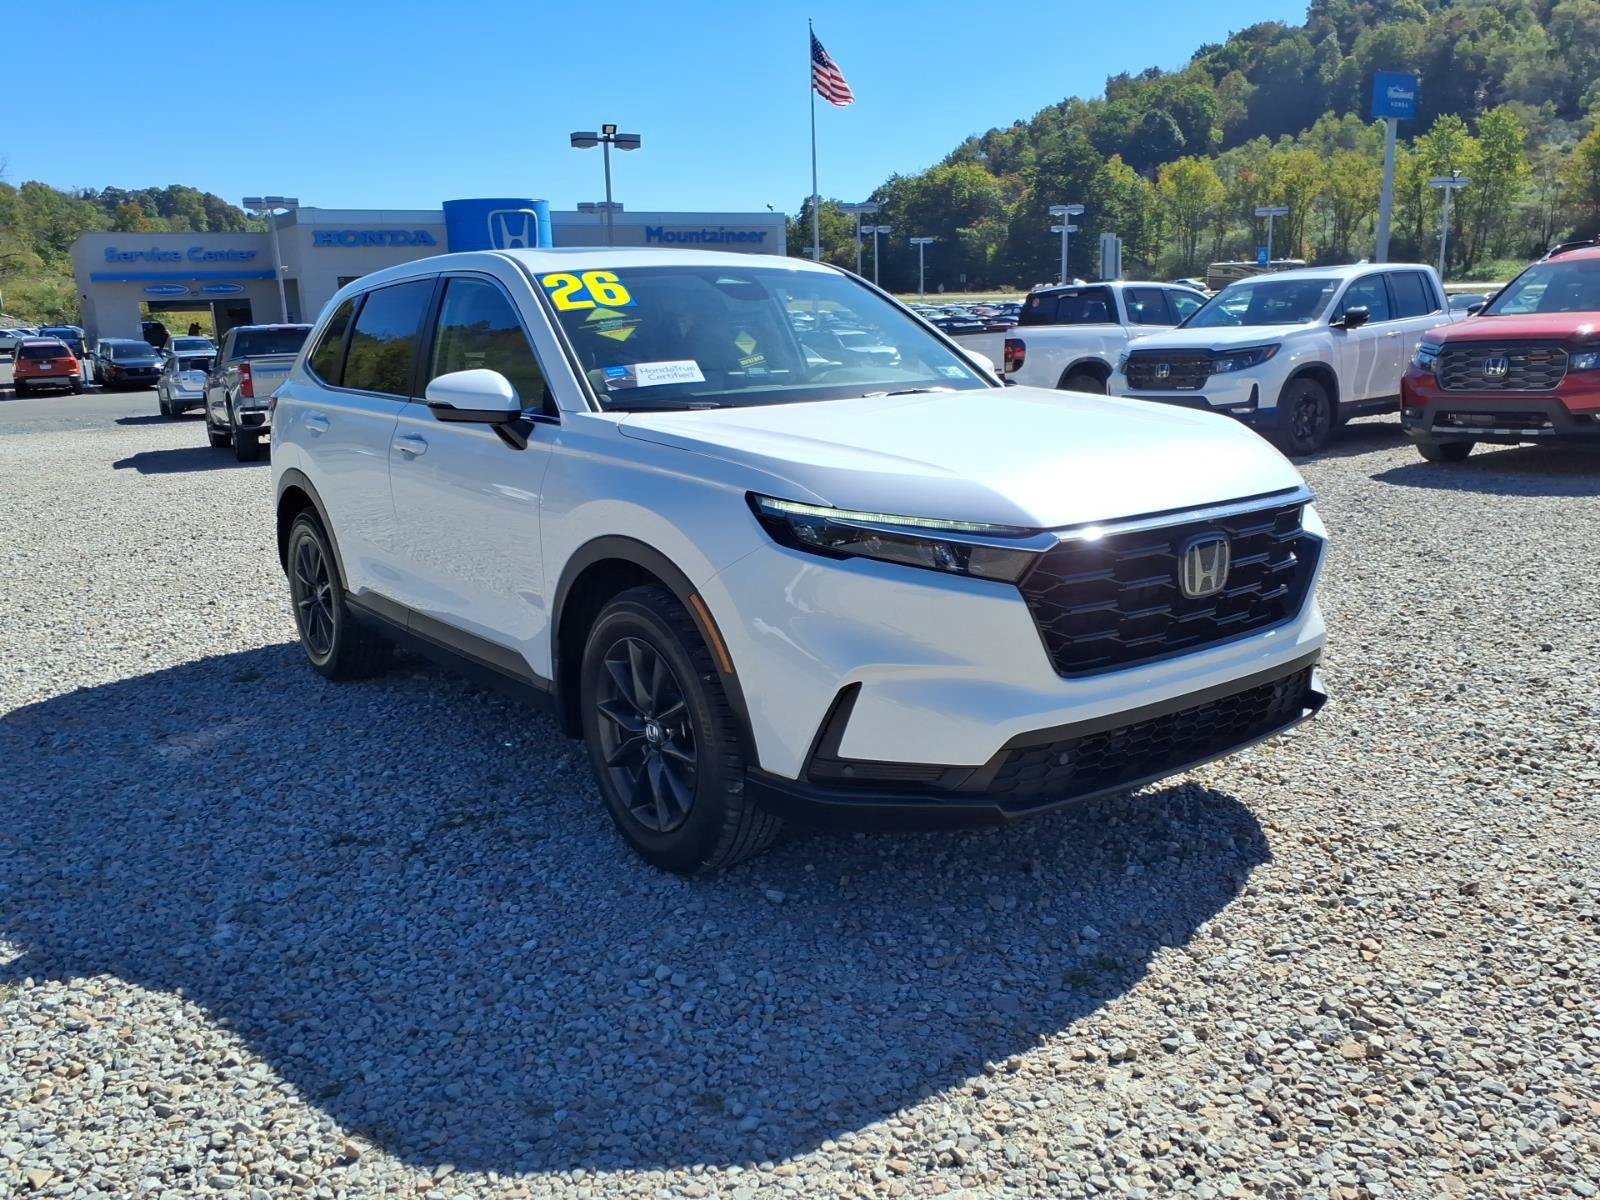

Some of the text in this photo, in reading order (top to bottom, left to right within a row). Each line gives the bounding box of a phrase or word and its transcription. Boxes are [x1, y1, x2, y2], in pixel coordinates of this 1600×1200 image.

[312, 230, 437, 247] HONDA
[645, 226, 768, 243] Mountaineer
[104, 247, 257, 262] Service Center
[542, 271, 631, 311] 26
[639, 365, 696, 374] HondaTrue
[647, 371, 695, 381] Certified
